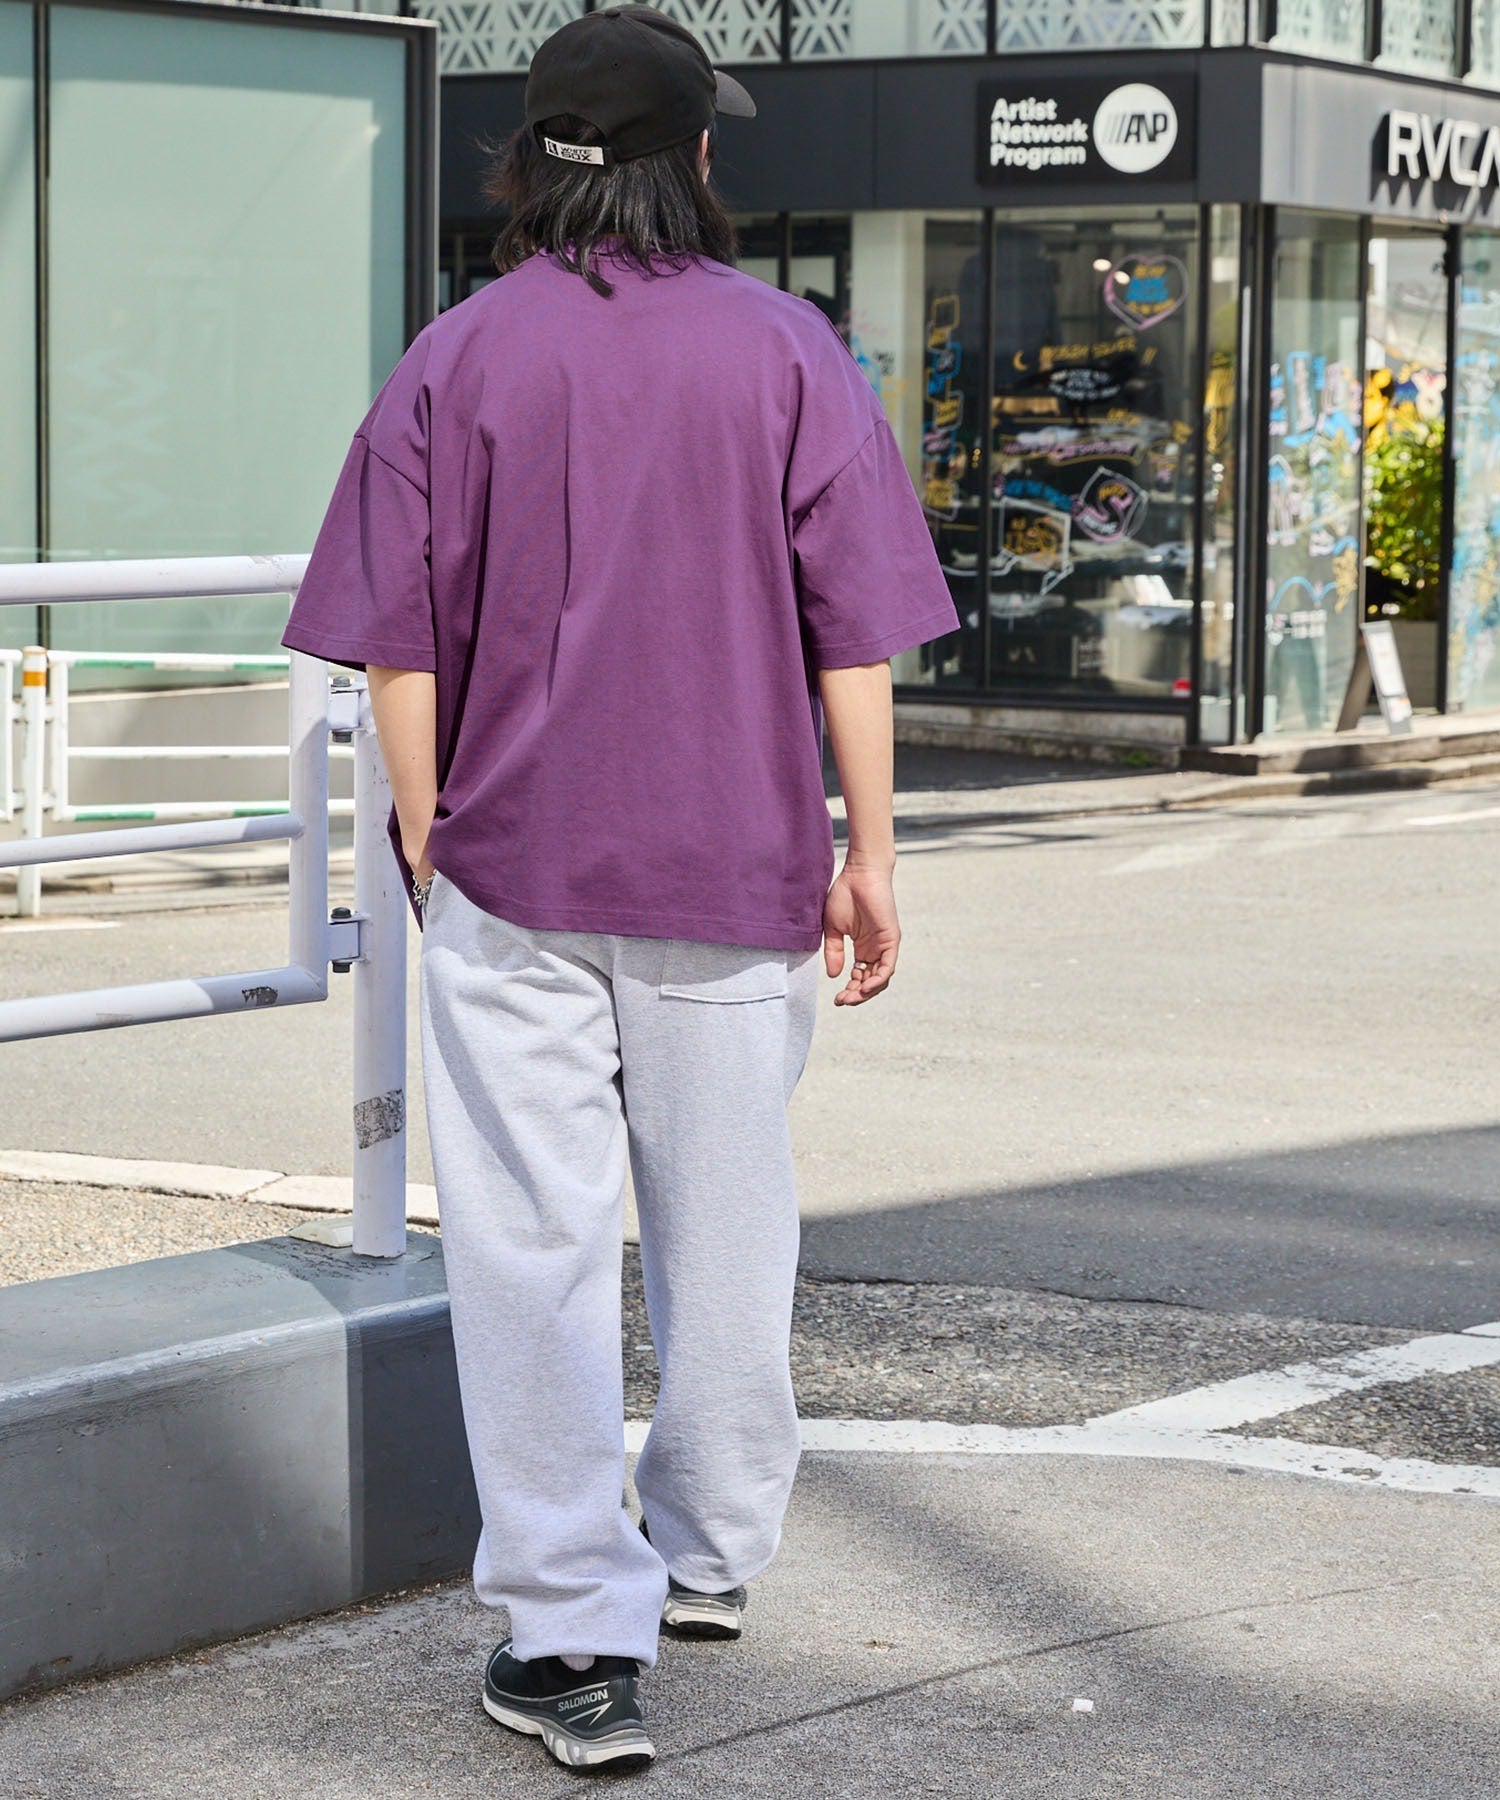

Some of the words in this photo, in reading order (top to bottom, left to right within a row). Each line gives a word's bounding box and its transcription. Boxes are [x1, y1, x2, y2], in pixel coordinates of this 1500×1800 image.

[991, 97, 1058, 122] Artist
[990, 118, 1089, 144] Network
[990, 143, 1087, 171] Program
[557, 1688, 609, 1712] SALOMON
